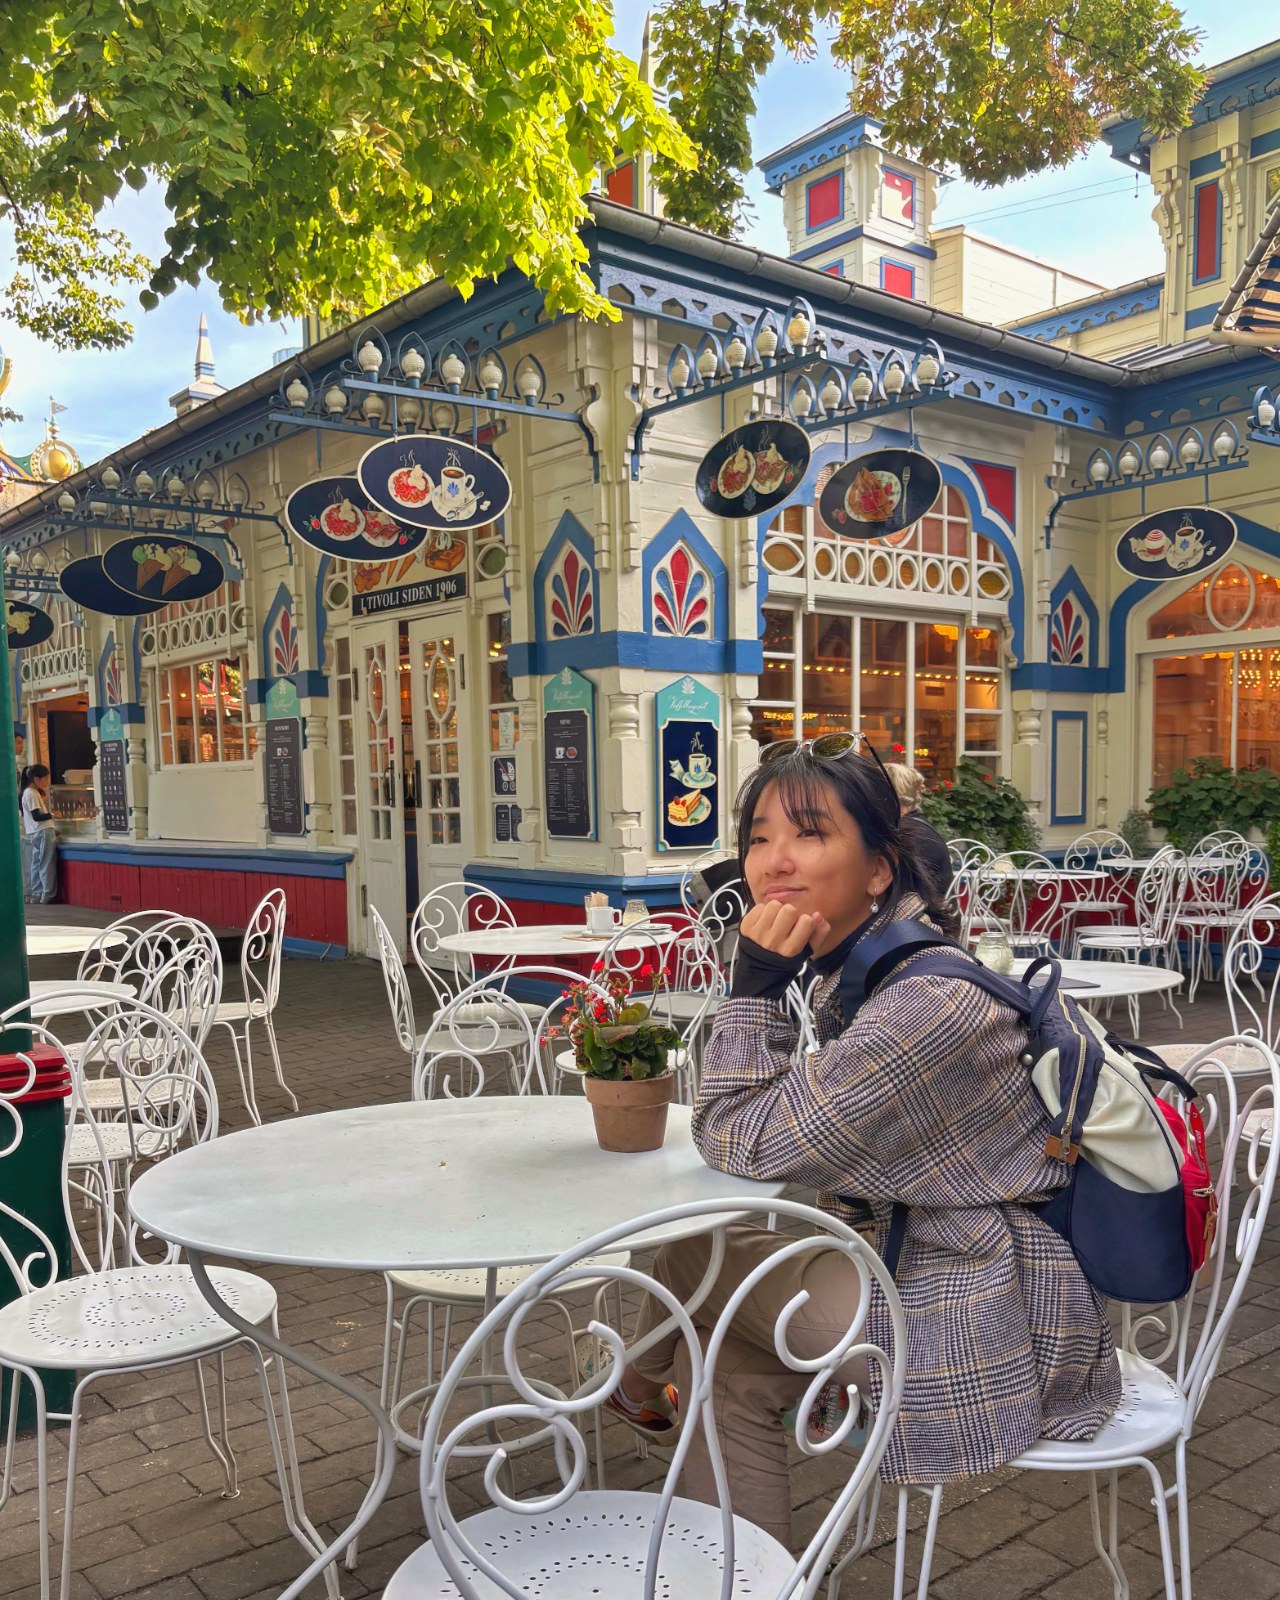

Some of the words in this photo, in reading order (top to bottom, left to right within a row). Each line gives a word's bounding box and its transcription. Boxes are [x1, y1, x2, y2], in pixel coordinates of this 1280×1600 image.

[367, 591, 399, 610] TIVOLI
[402, 584, 433, 604] SIDEN
[436, 579, 457, 597] 1906
